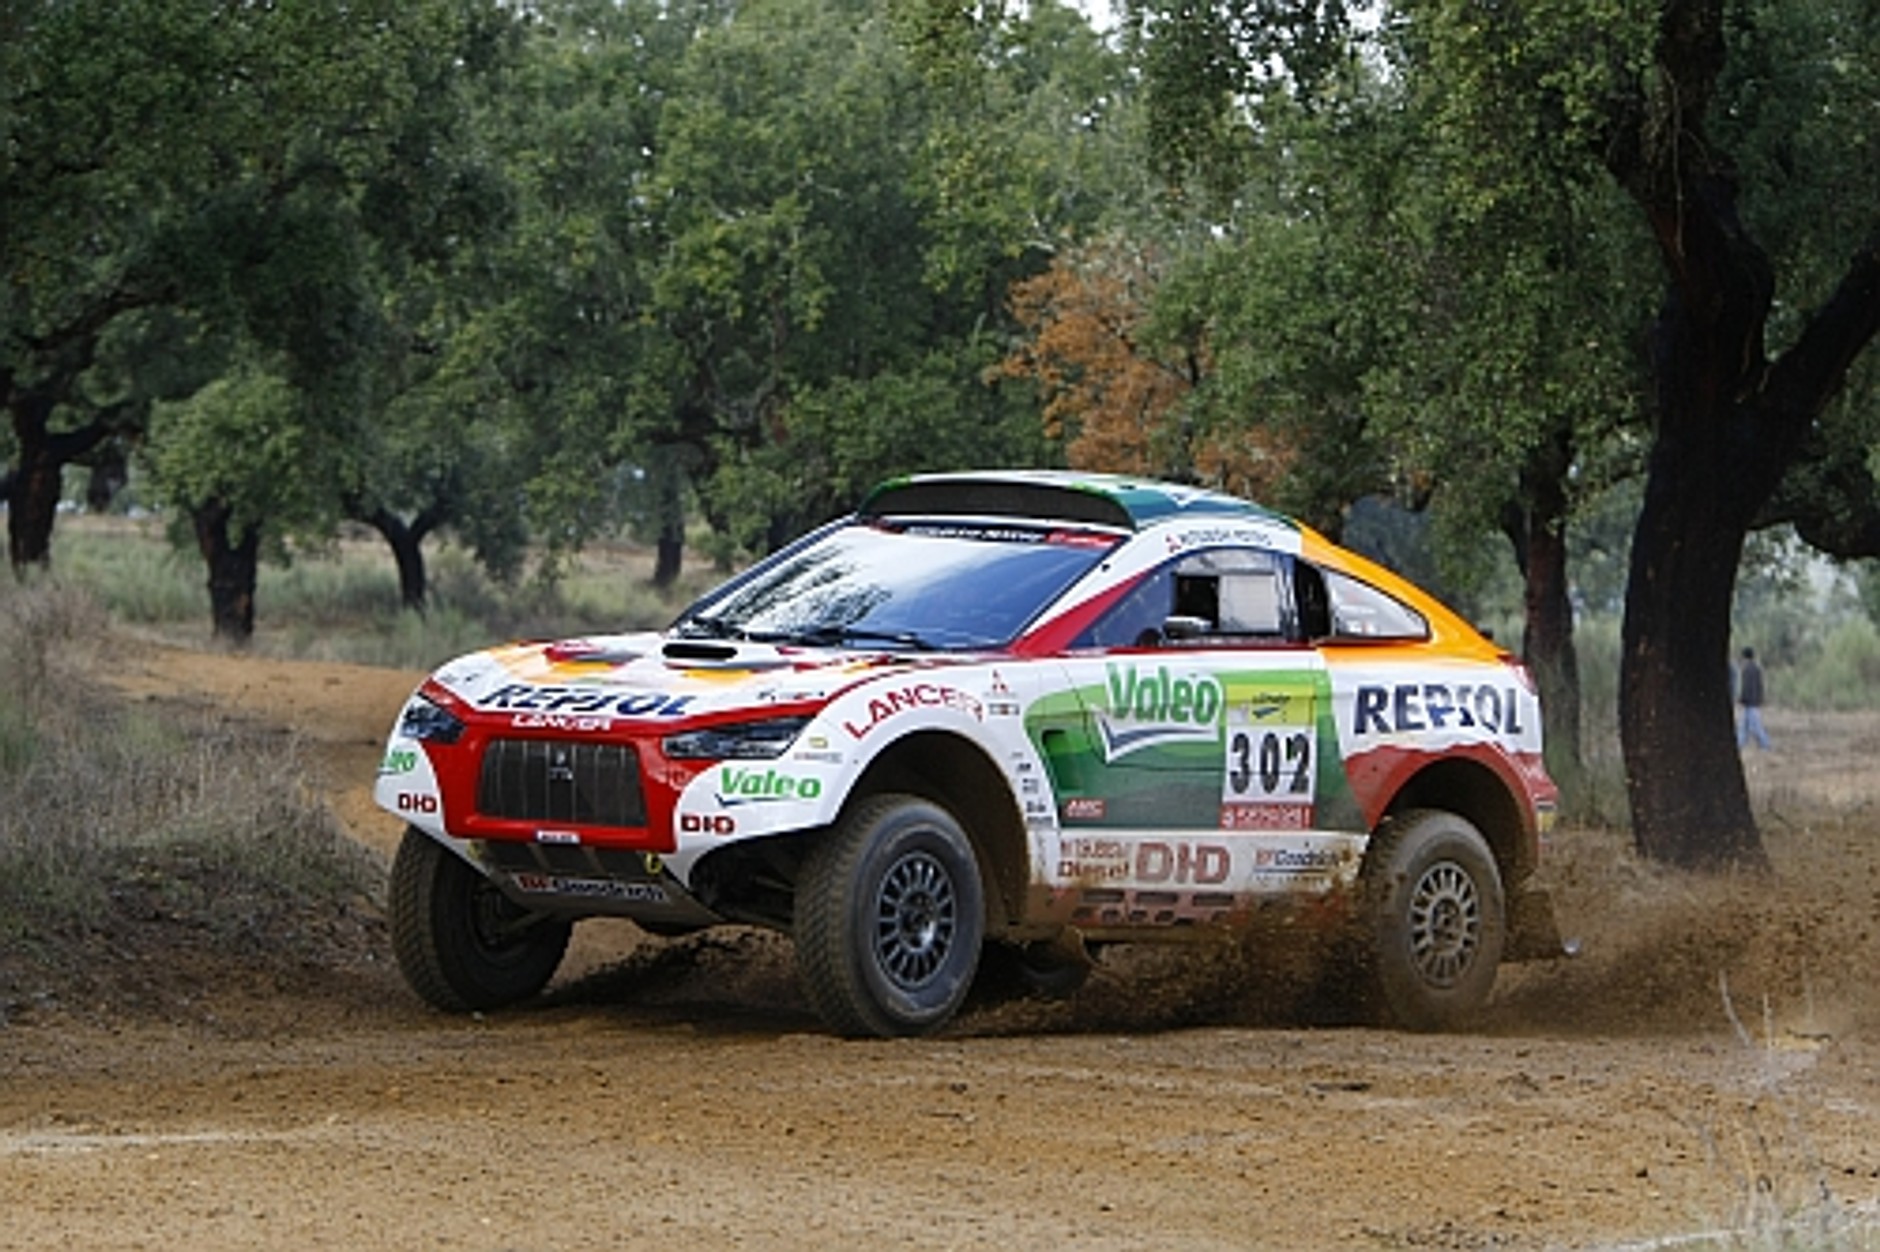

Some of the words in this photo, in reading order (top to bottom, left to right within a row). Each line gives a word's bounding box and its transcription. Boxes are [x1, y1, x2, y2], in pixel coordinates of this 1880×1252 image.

[477, 684, 698, 716] REPSOL
[1105, 662, 1220, 724] Valeo
[1353, 683, 1524, 735] REPSOL
[511, 713, 613, 731] LANCER
[720, 767, 822, 798] Valeo
[1229, 732, 1311, 794] 302
